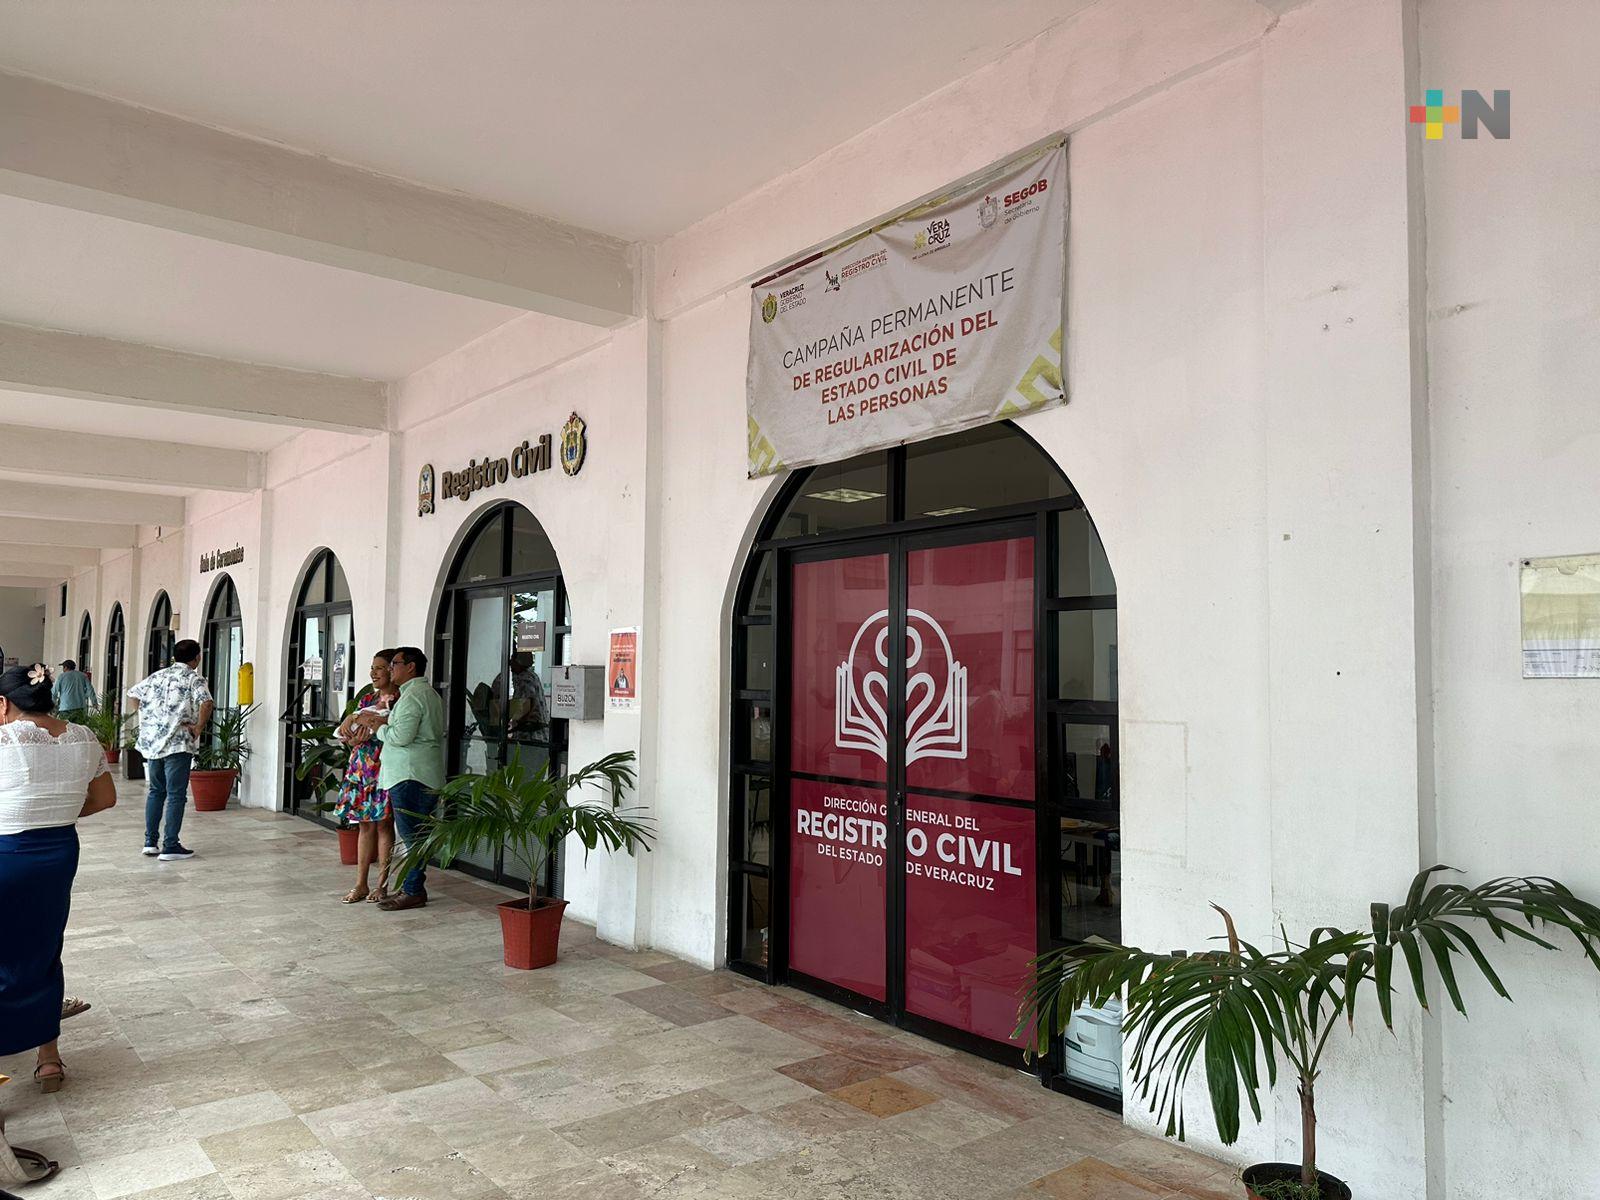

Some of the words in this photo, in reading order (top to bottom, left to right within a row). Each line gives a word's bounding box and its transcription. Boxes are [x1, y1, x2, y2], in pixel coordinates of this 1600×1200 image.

[1003, 178, 1048, 208] SEGOB
[927, 218, 950, 235] VERA
[927, 227, 951, 245] CRUZ
[841, 260, 871, 278] REGISTRO
[871, 254, 888, 266] CIVIL
[780, 283, 804, 299] VERACRUZ
[780, 304, 789, 314] DEL
[788, 298, 807, 310] ESTADO
[783, 325, 865, 369] CAMPAÑA
[870, 267, 1015, 339] PERMANENTE
[793, 371, 811, 391] DE
[815, 322, 954, 384] REGULARIZACIÓN
[961, 309, 998, 336] DEL
[821, 373, 880, 404] ESTADO
[884, 356, 928, 385] CIVIL
[932, 347, 957, 371] DE
[828, 403, 855, 425] LAS
[860, 376, 949, 417] PERSONAS
[442, 456, 509, 501] Registro
[511, 433, 552, 478] Civil
[823, 796, 877, 815] DIRECCIÓN
[955, 816, 980, 832] DEL
[817, 843, 838, 857] DEL
[839, 847, 883, 867] ESTADO
[906, 861, 922, 876] DE
[924, 864, 995, 891] VERACRUZ
[936, 832, 1022, 876] CIVIL
